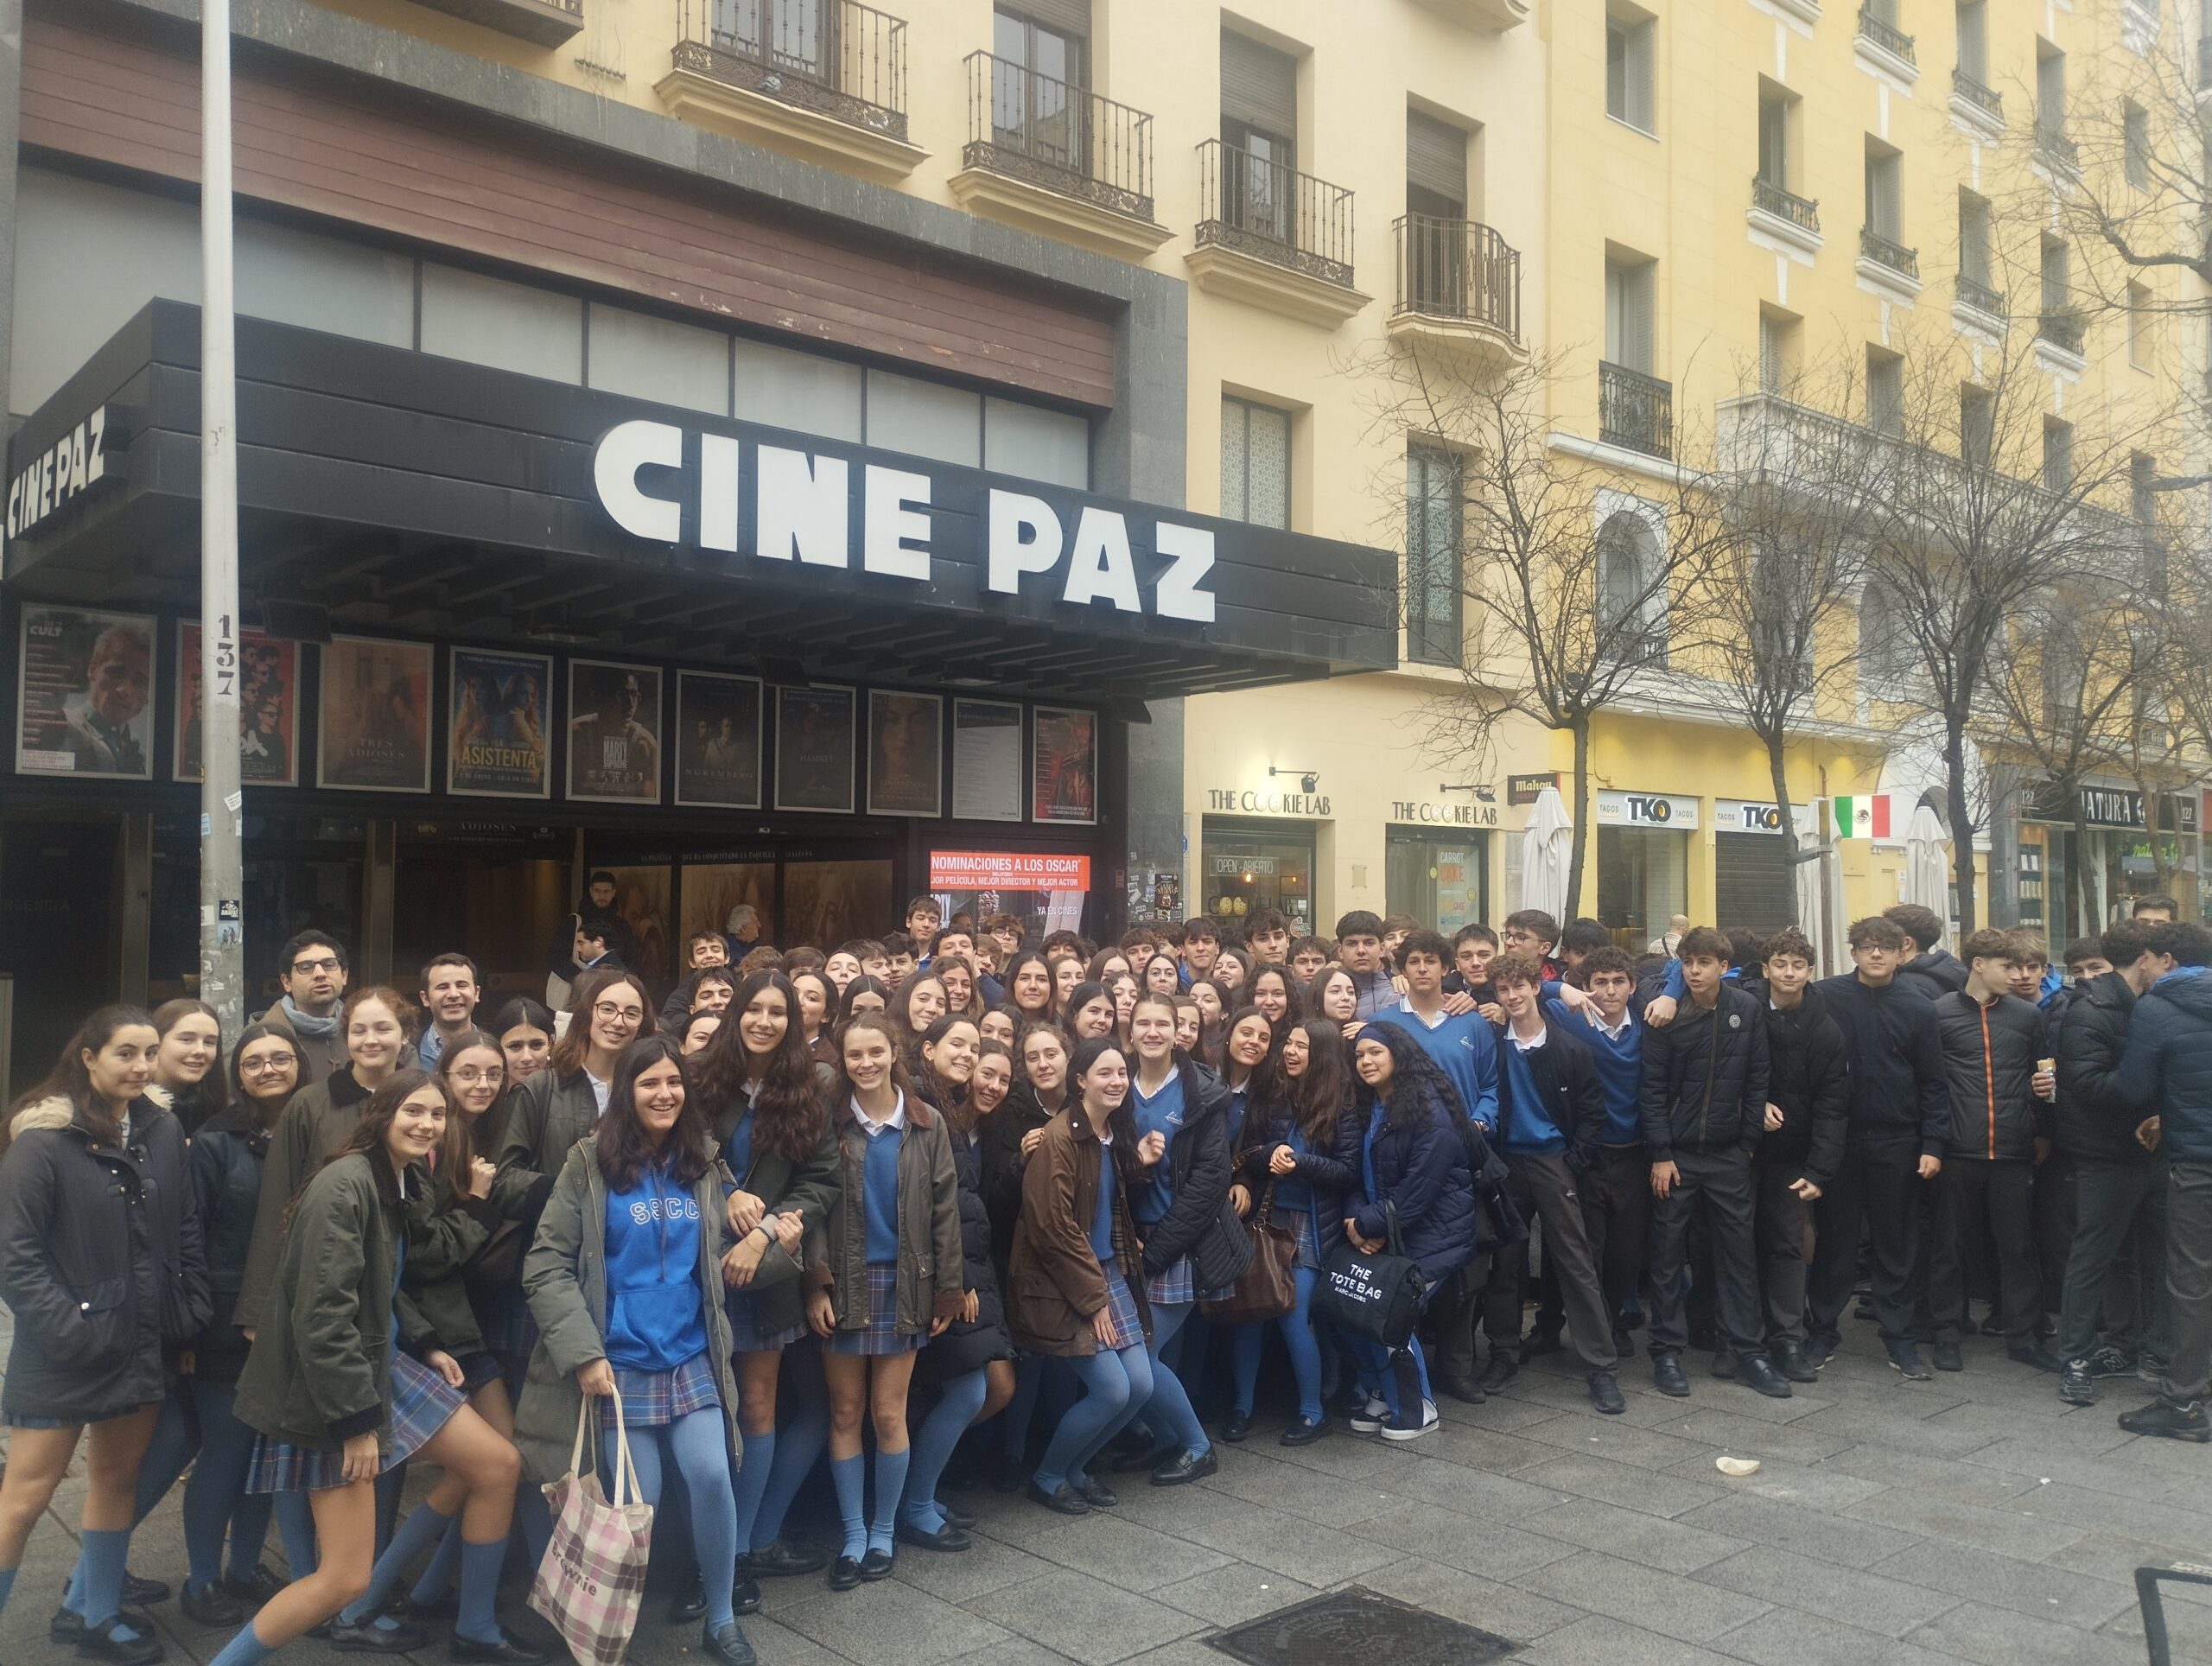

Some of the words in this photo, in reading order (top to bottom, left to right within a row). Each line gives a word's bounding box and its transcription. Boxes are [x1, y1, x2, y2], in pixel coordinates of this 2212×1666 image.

[594, 419, 931, 581] CINE
[988, 487, 1216, 622] PAZ
[29, 625, 62, 637] CULT
[461, 745, 537, 769] ASISTENTA
[603, 741, 627, 760] MARTY
[800, 754, 834, 763] HAMNET
[1515, 779, 1552, 792] Mahou
[1208, 790, 1236, 811] THE
[1241, 791, 1302, 814] COOKIE
[1306, 796, 1331, 815] LAB
[1599, 804, 1619, 813] TACOS
[1626, 797, 1672, 823] TKO
[1392, 802, 1415, 821] THE
[1420, 803, 1471, 823] COOKIE
[1473, 806, 1497, 825] LAB
[1742, 805, 1783, 830] TKO
[931, 856, 1012, 872] NOMINACIONES
[1014, 859, 1021, 870] A
[1024, 859, 1043, 872] LOS
[1217, 859, 1237, 873] OPEN
[1243, 861, 1274, 874] ABIERTO
[1440, 852, 1465, 864] CARROT
[945, 875, 977, 886] PELÍCULA,
[978, 876, 1000, 886] MEJOR
[1001, 877, 1031, 886] DIRECTOR
[1037, 878, 1058, 887] MEJOR
[1440, 867, 1465, 883] CAKE
[1037, 906, 1046, 915] YA
[1047, 906, 1056, 915] EN
[1058, 906, 1077, 915] CINES
[630, 1198, 700, 1225] SSCC
[1350, 1263, 1372, 1281] THE
[1330, 1271, 1357, 1289] TOTE
[1356, 1281, 1382, 1300] BAG
[551, 1540, 597, 1597] Brownie
